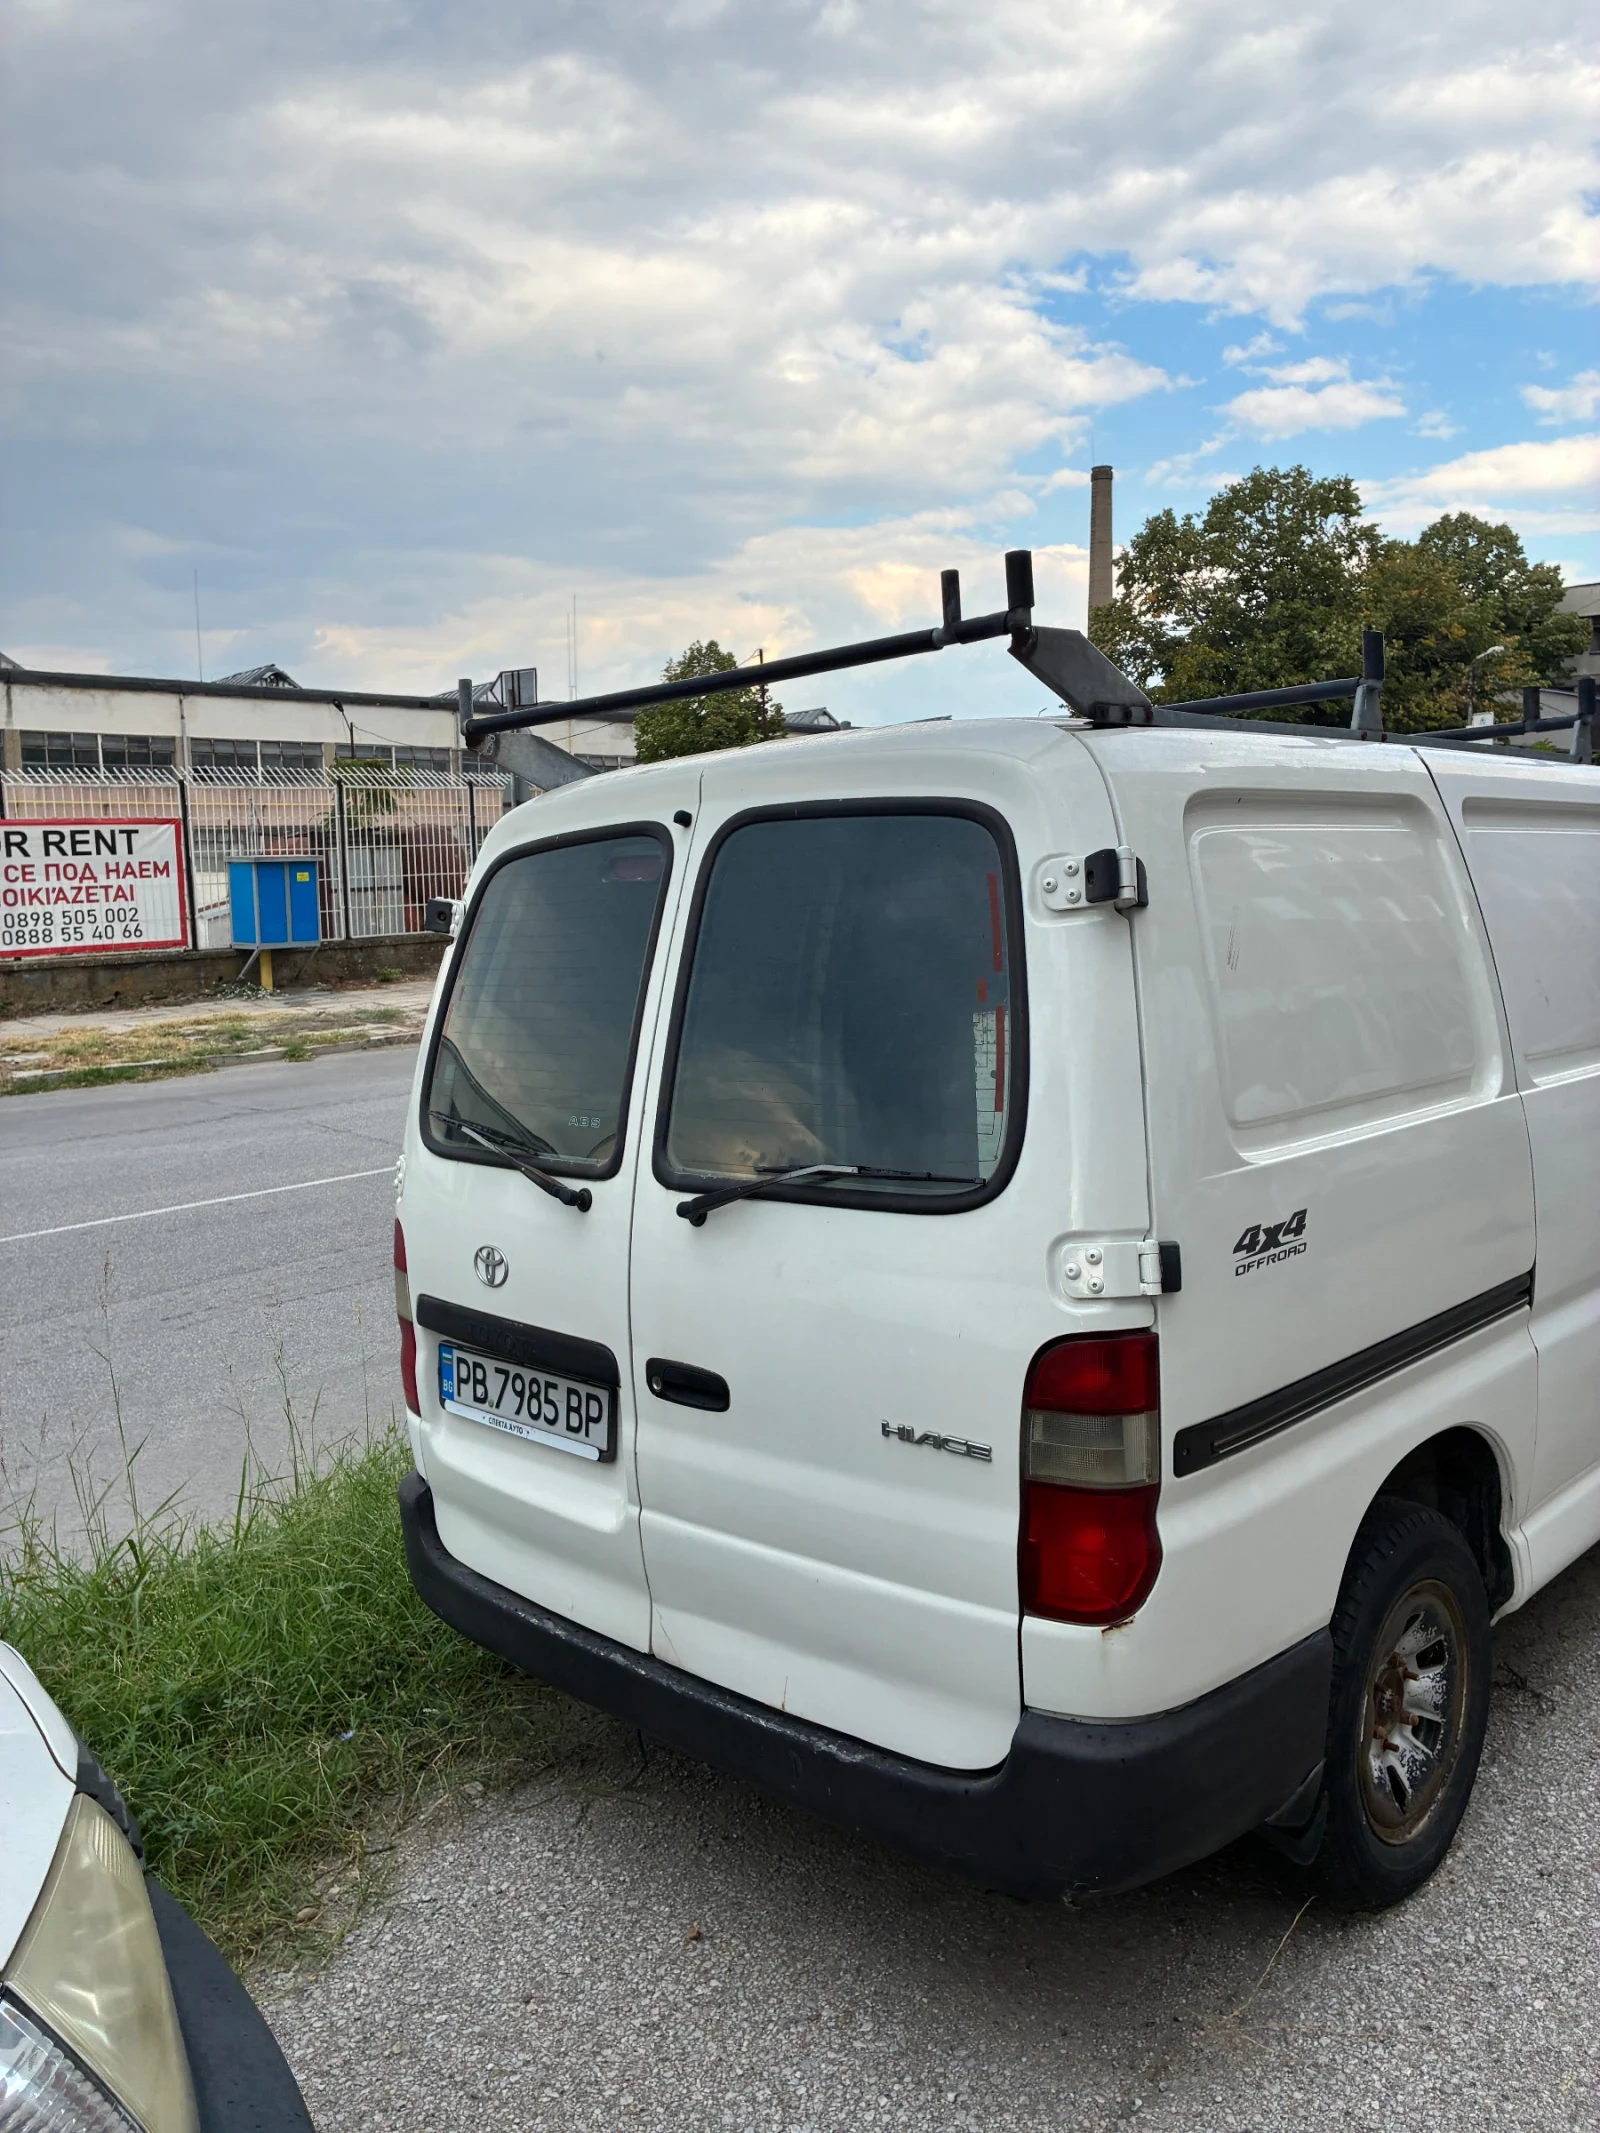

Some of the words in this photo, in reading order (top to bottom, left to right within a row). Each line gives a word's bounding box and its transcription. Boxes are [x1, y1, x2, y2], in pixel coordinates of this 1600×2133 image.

[0, 830, 31, 858] R
[42, 829, 139, 857] RENT
[4, 864, 36, 883] СЕ
[44, 862, 98, 884] ПОД
[105, 861, 170, 880] НАЕМ
[4, 911, 54, 929] 0898
[62, 909, 98, 926] 505
[105, 907, 139, 923] 002
[2, 929, 53, 946] 0888
[61, 926, 84, 942] 55
[92, 924, 115, 940] 40
[122, 923, 143, 938] 66
[568, 1115, 601, 1129] ABS
[1235, 1242, 1307, 1277] OFFROAD
[443, 1378, 453, 1393] BG
[881, 1419, 993, 1463] HIACE
